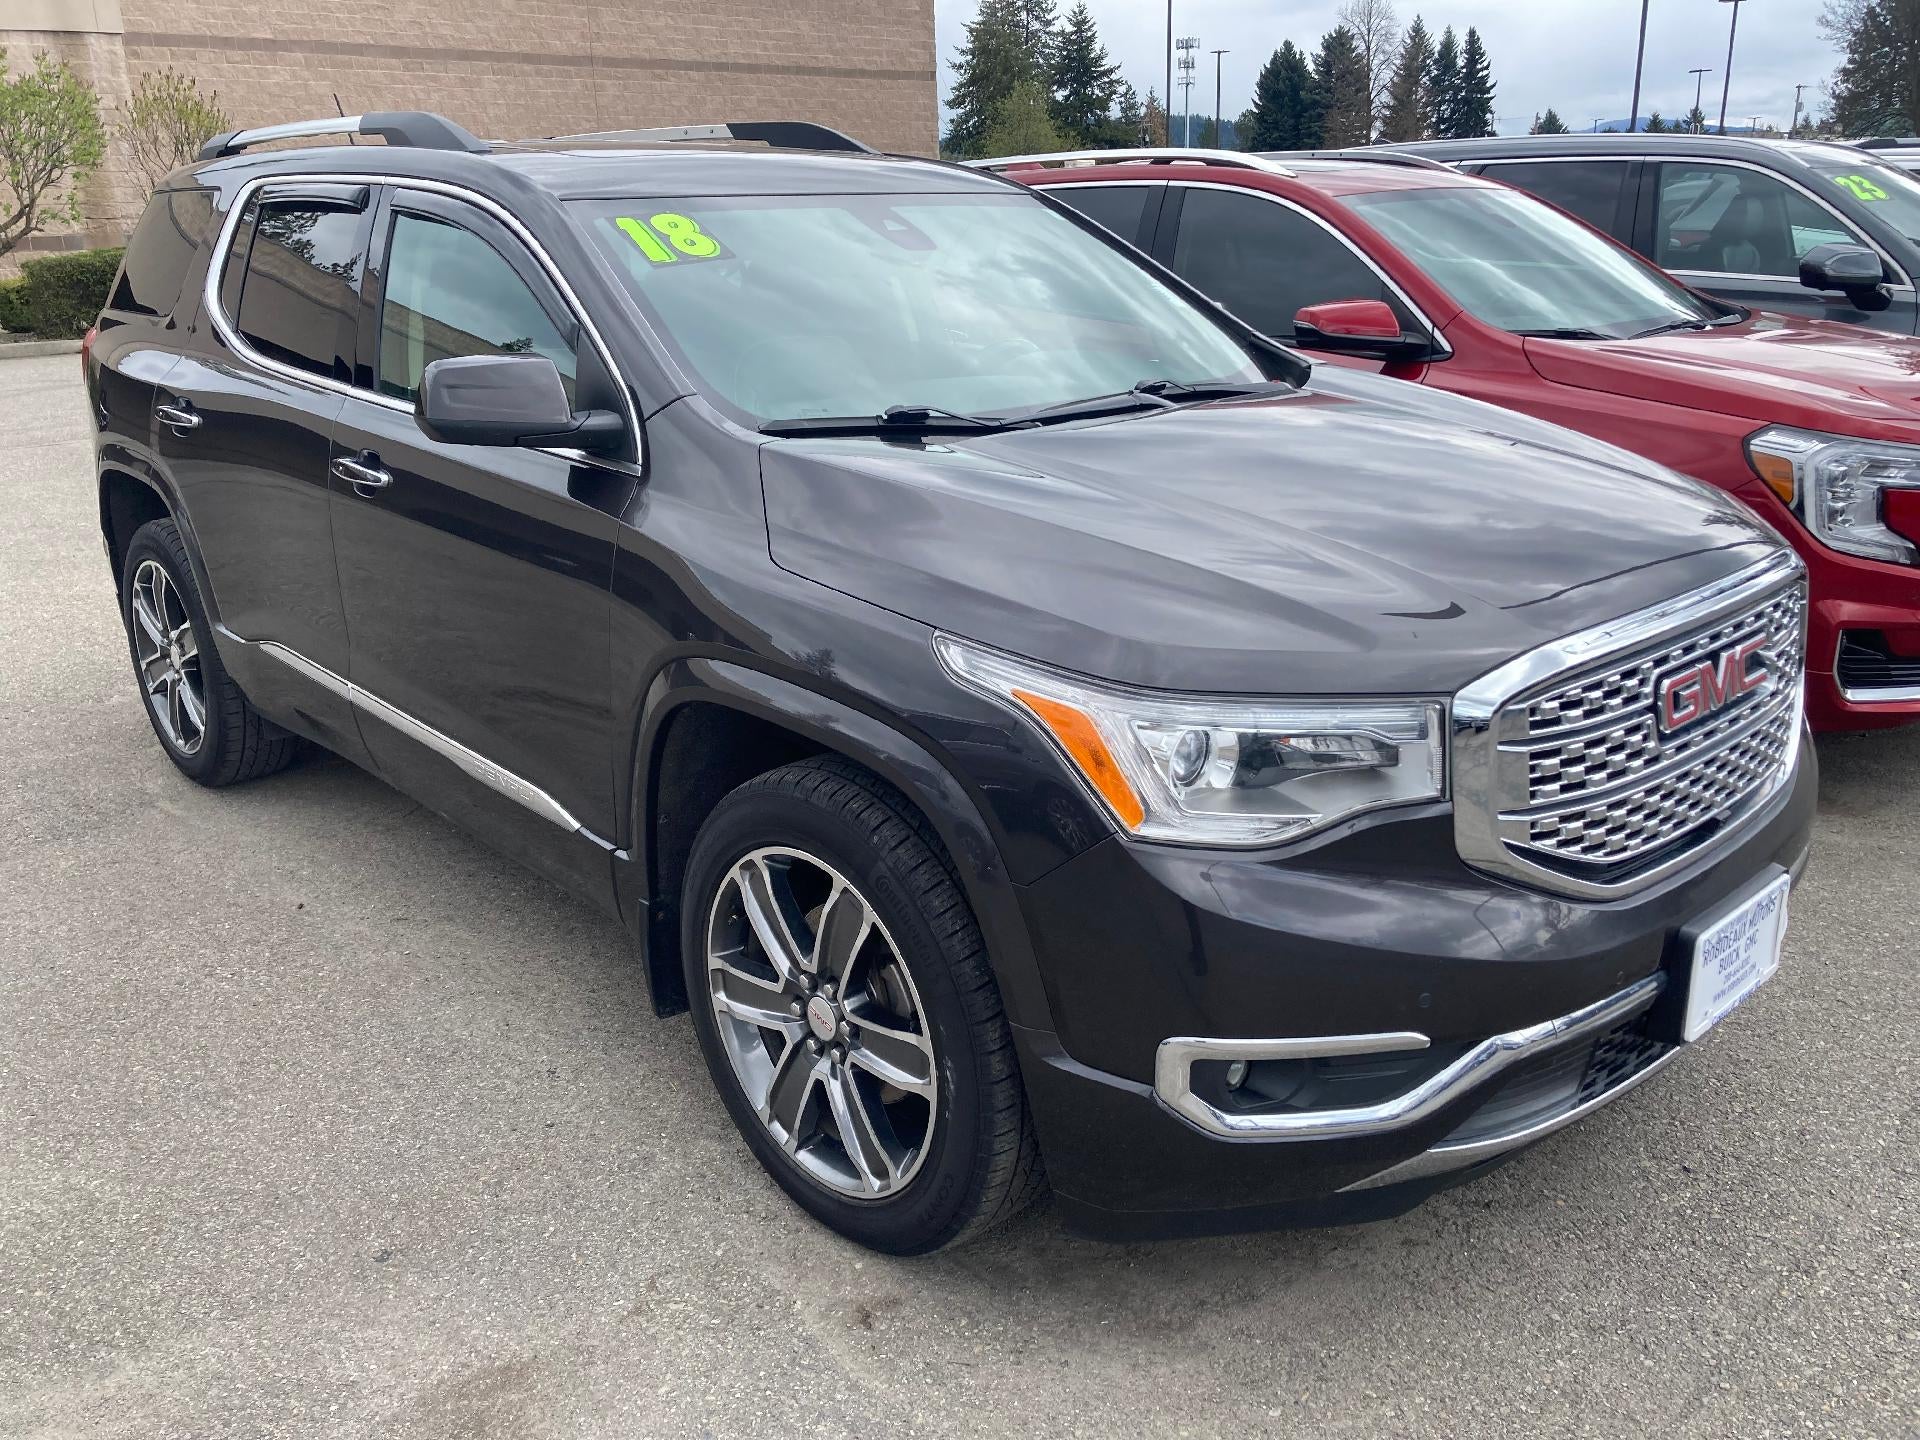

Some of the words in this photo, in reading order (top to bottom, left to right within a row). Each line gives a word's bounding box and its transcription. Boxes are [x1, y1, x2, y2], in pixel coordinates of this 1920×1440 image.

[1834, 175, 1890, 201] 23
[615, 213, 721, 262] 18
[1658, 632, 1769, 734] GMC
[1703, 921, 1747, 968] ROBIDEAUX
[1748, 895, 1776, 928] MOTORS
[1719, 946, 1741, 975] BUICK
[1745, 928, 1759, 954] GMC
